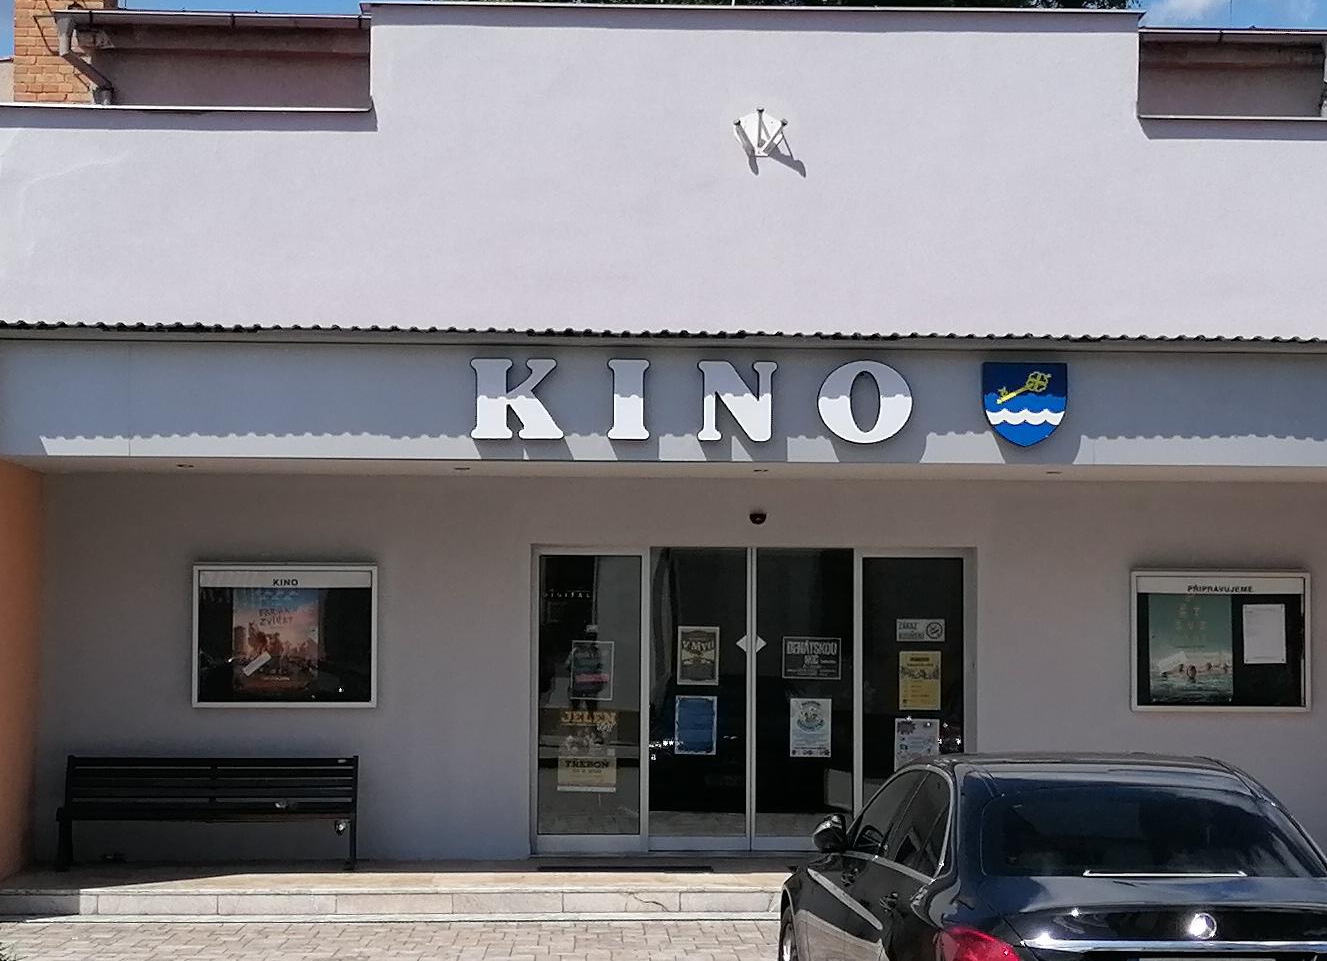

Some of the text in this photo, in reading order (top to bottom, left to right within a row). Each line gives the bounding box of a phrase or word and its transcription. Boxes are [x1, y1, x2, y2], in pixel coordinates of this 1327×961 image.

[470, 357, 914, 445] KINO
[273, 578, 299, 587] KINO
[1187, 583, 1255, 594] PŘIPRAVUJEME
[561, 710, 618, 725] JELEN
